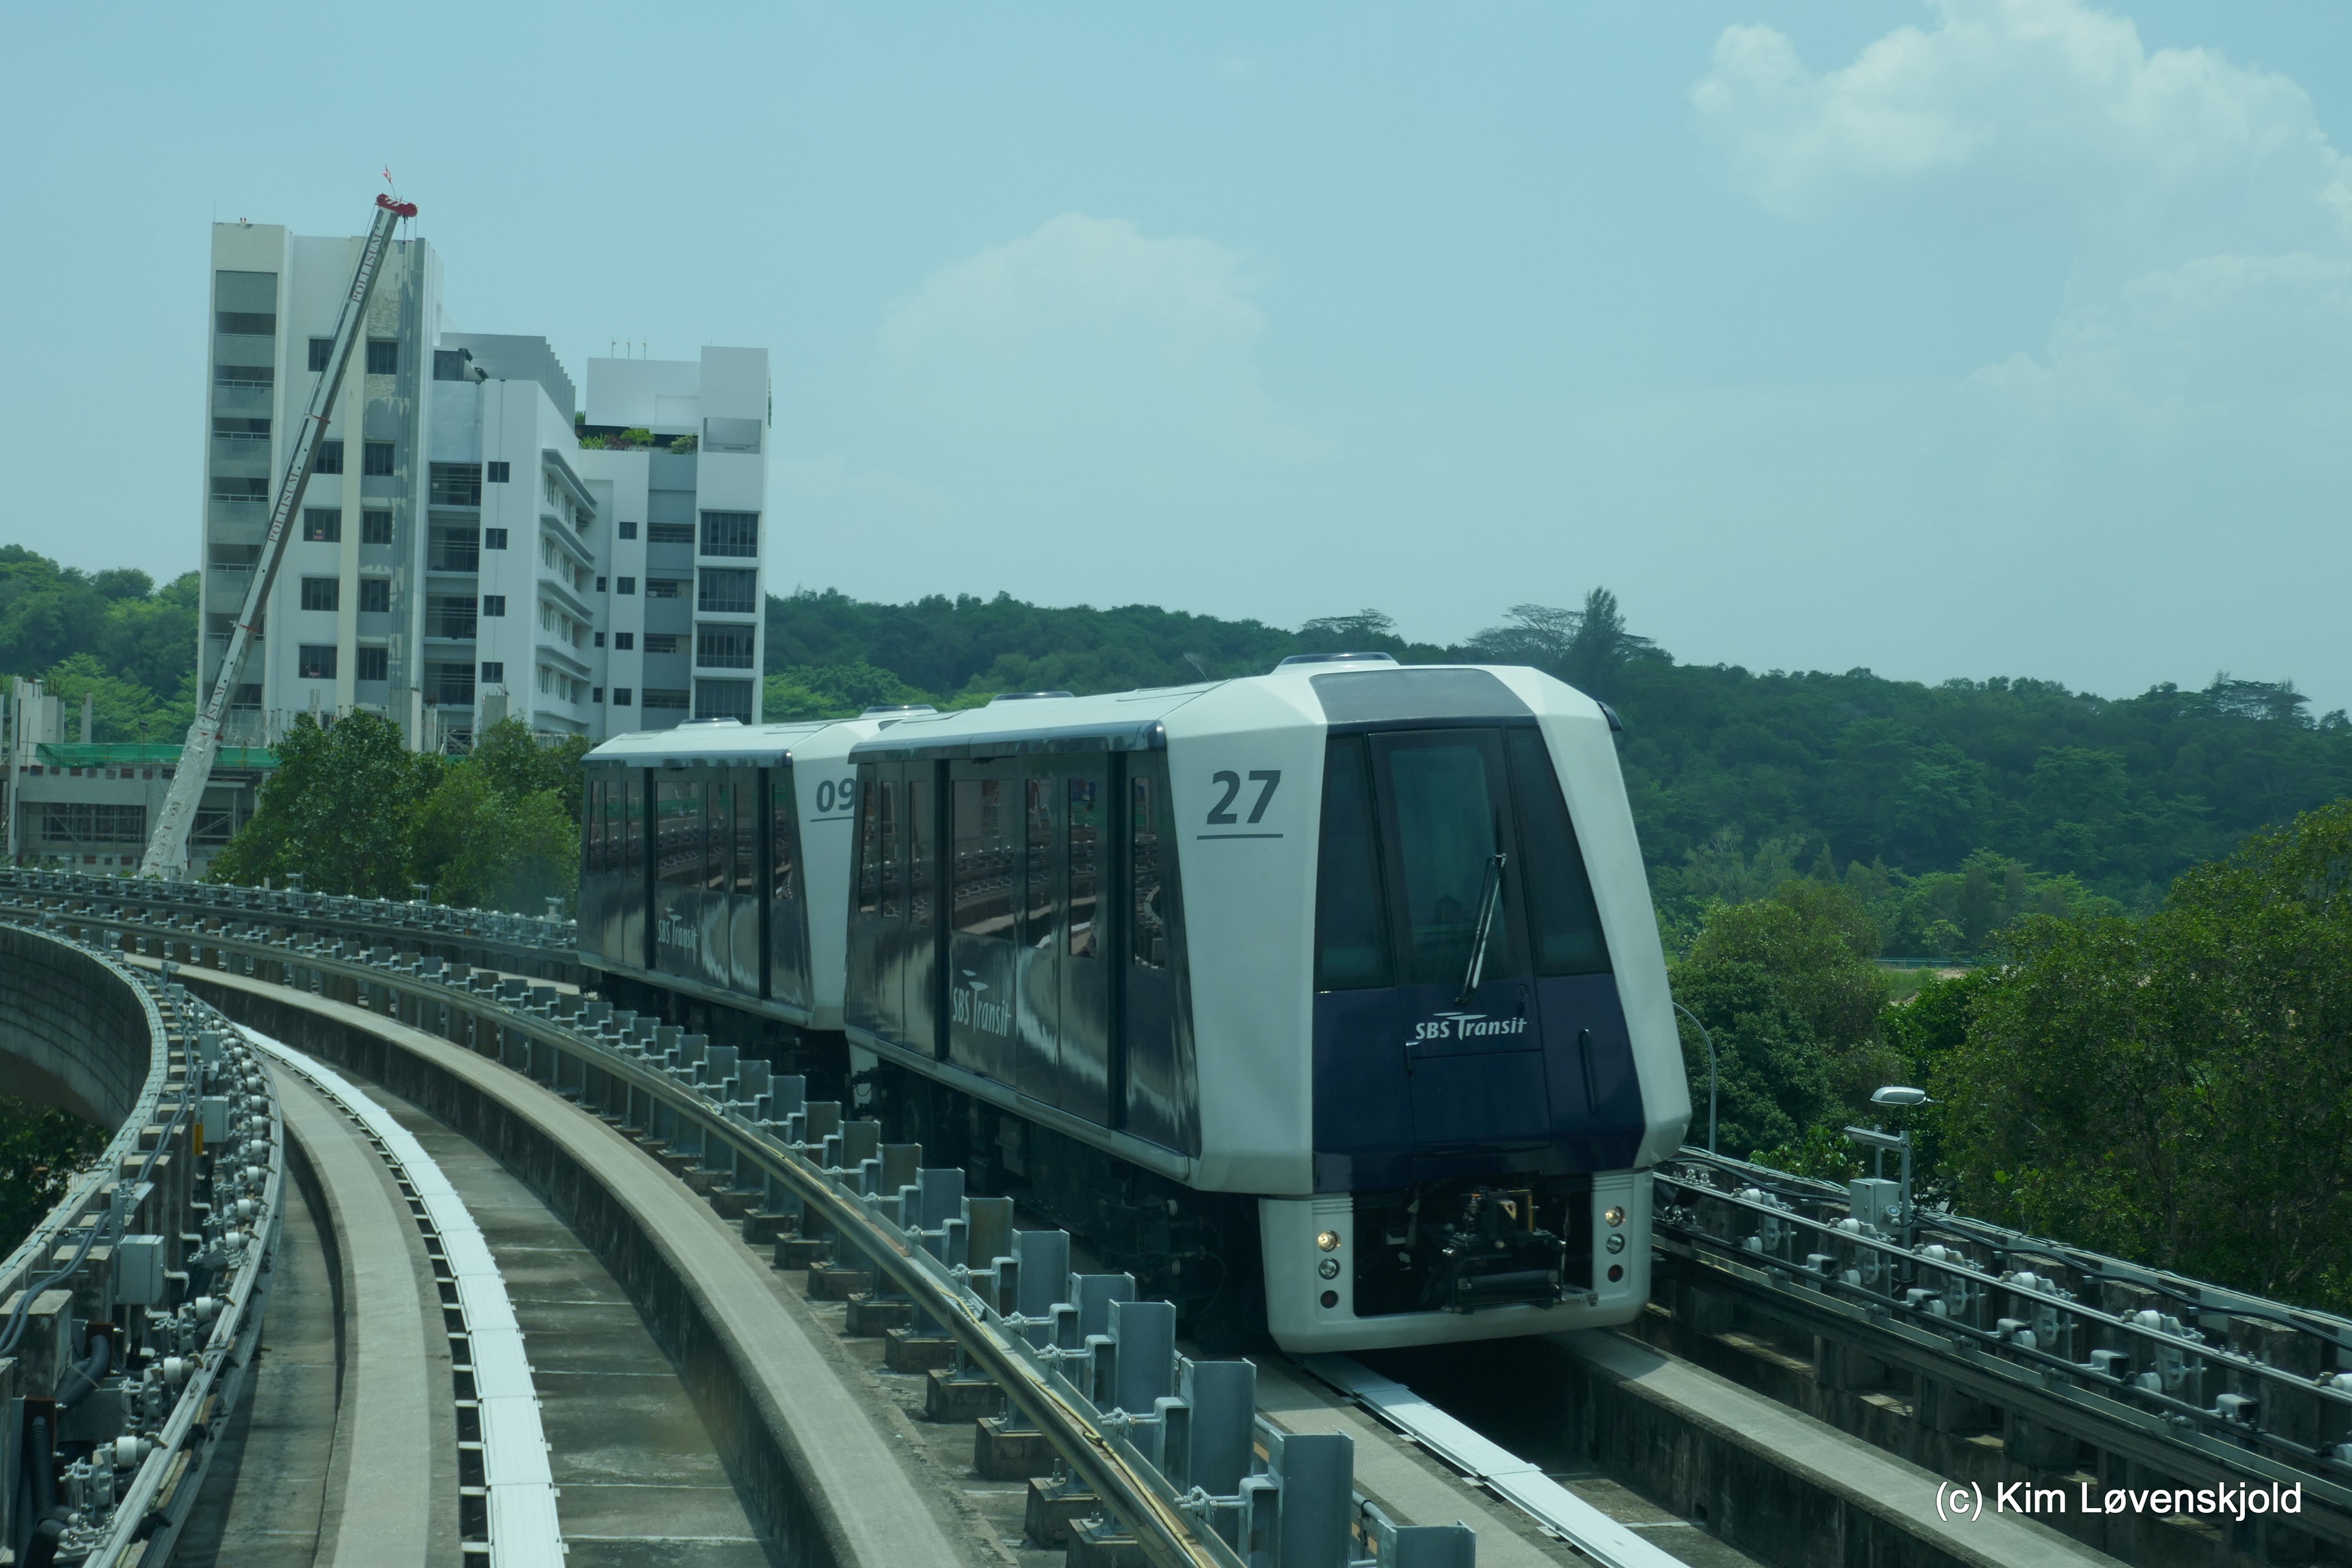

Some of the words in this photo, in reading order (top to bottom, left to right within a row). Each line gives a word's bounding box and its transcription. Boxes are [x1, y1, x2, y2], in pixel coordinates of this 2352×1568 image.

[352, 234, 383, 303] POLLISUM
[269, 470, 300, 543] POLLISUM
[816, 777, 857, 813] 09
[1207, 770, 1281, 825] 27
[658, 919, 670, 944] SBS
[669, 914, 698, 950] Transit
[952, 987, 970, 1025] SBS
[968, 981, 1012, 1037] Transit
[1415, 1021, 1450, 1040] SBS
[1447, 1014, 1528, 1040] Transit
